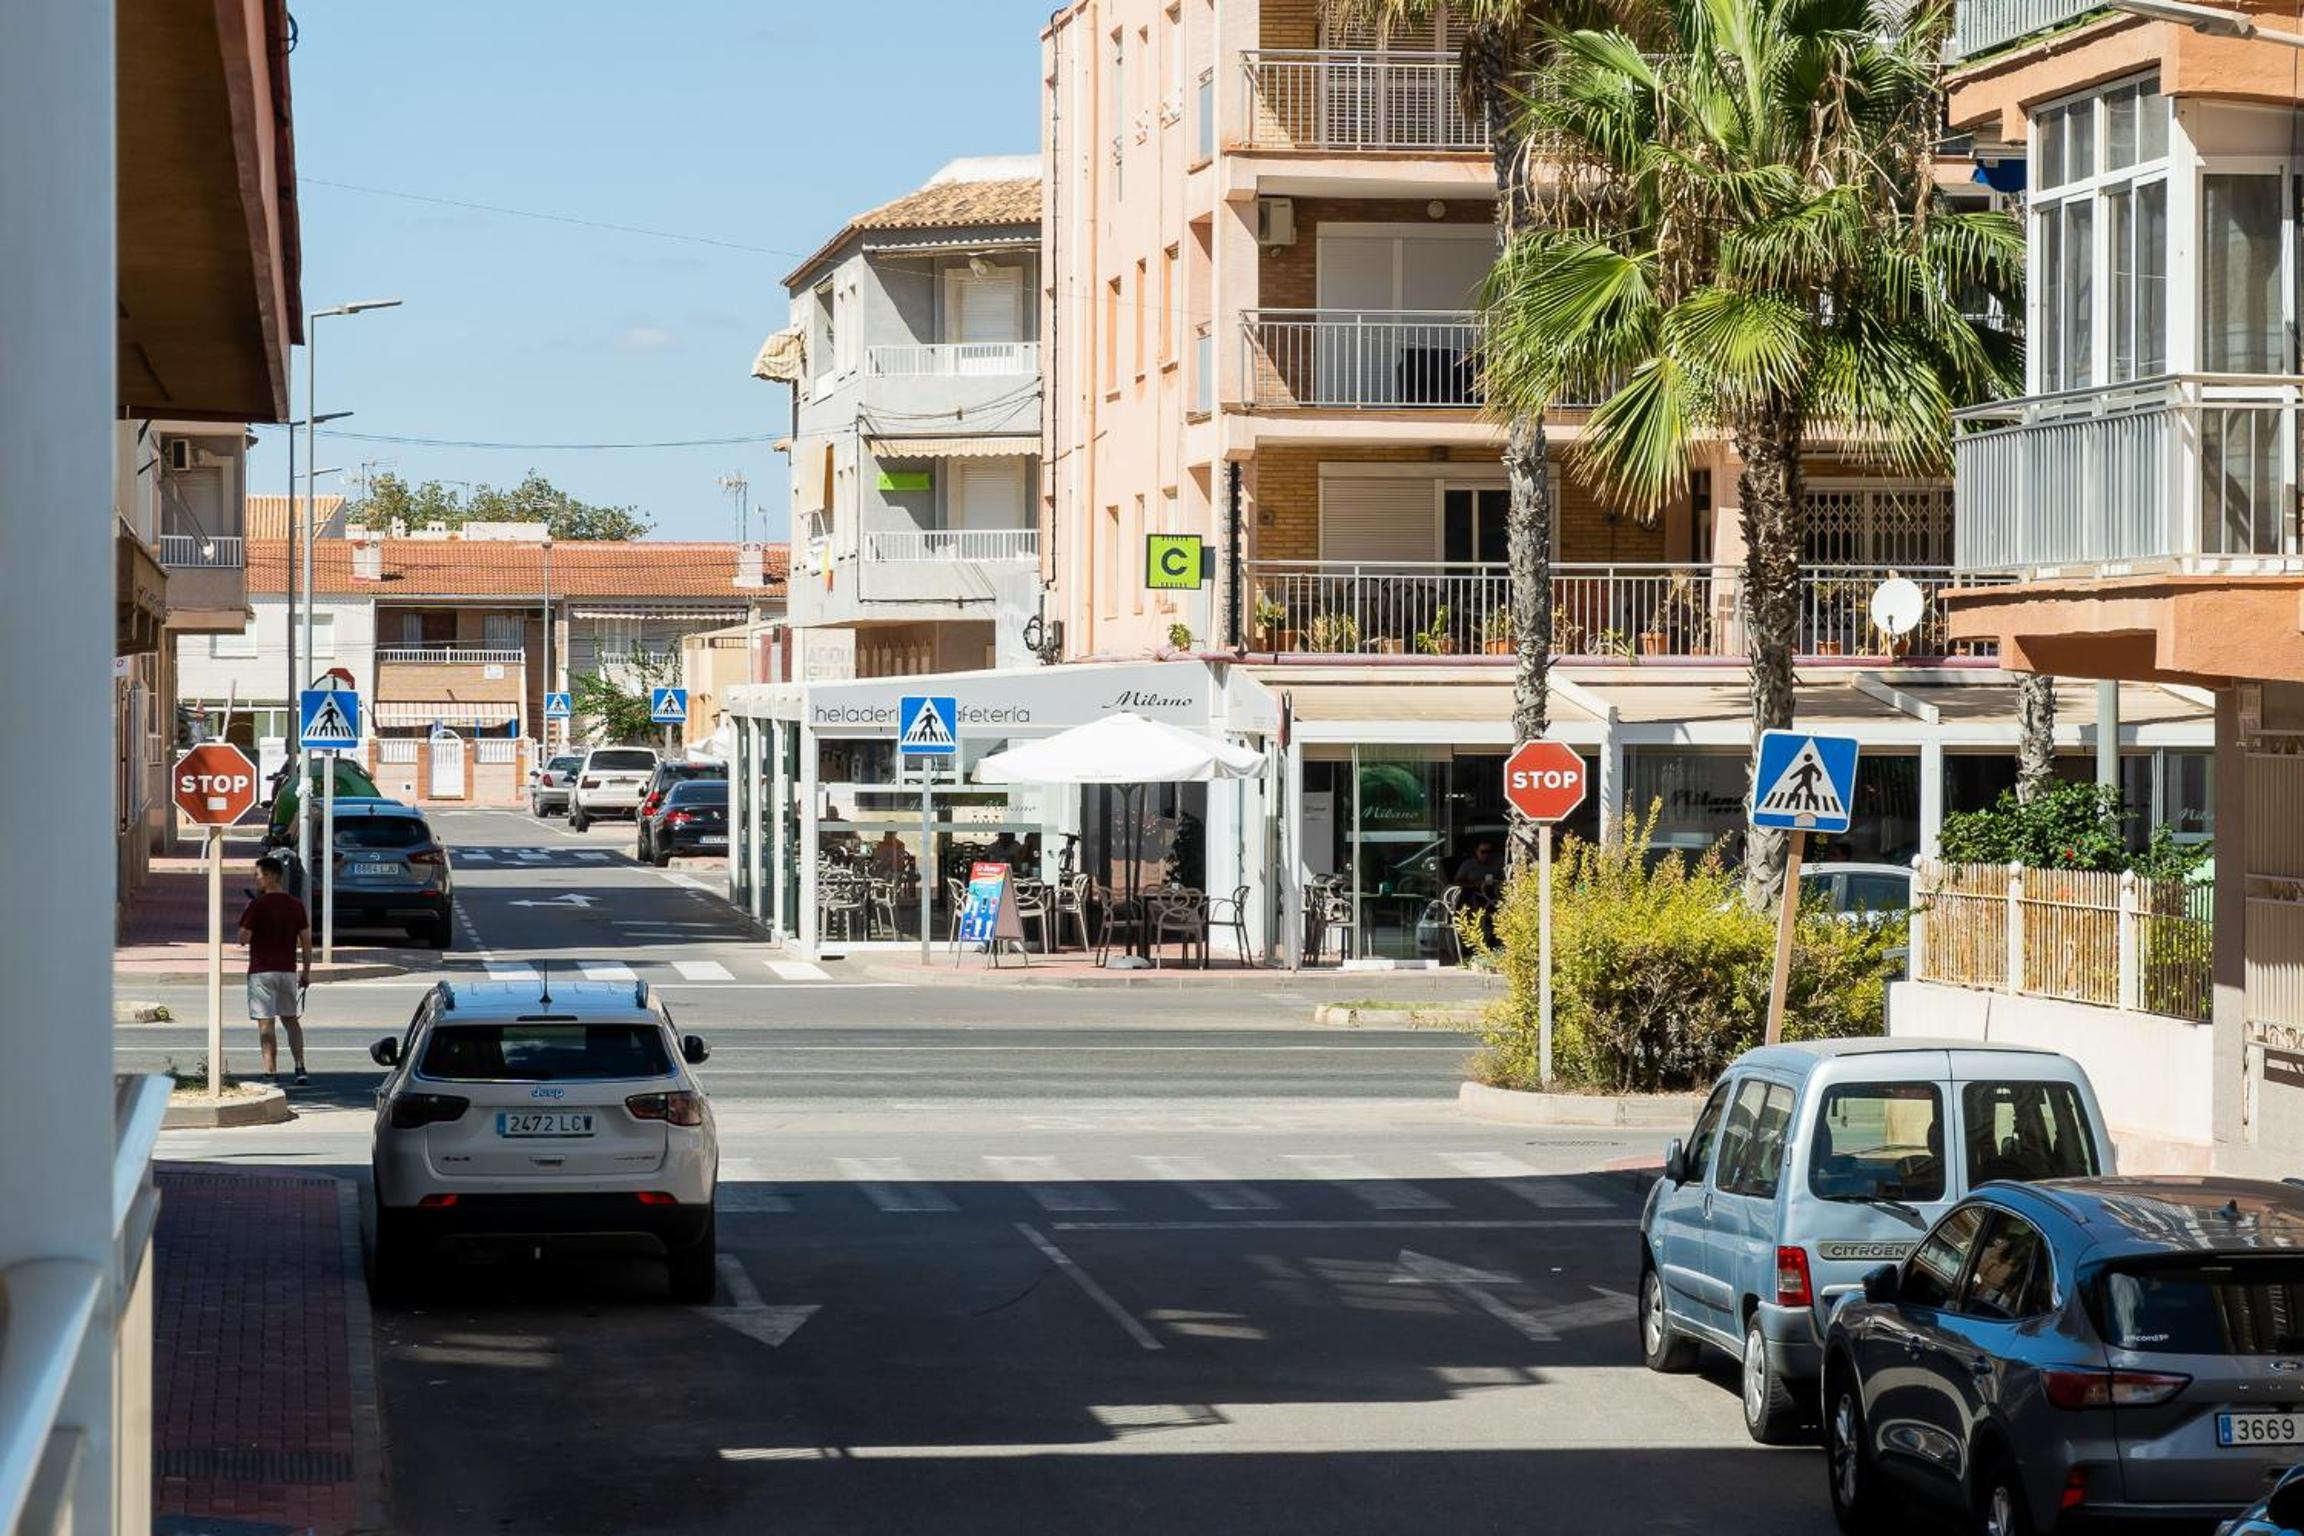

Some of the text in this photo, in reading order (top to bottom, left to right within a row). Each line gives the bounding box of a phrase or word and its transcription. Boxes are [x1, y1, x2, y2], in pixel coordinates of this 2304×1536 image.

[1161, 547, 1188, 576] C
[1101, 690, 1193, 709] Milano
[815, 704, 1030, 723] heladerí fetería
[180, 774, 249, 794] STOP
[1512, 770, 1579, 790] STOP
[510, 1115, 593, 1132] 2472 LCW
[2238, 1418, 2296, 1441] 3669
